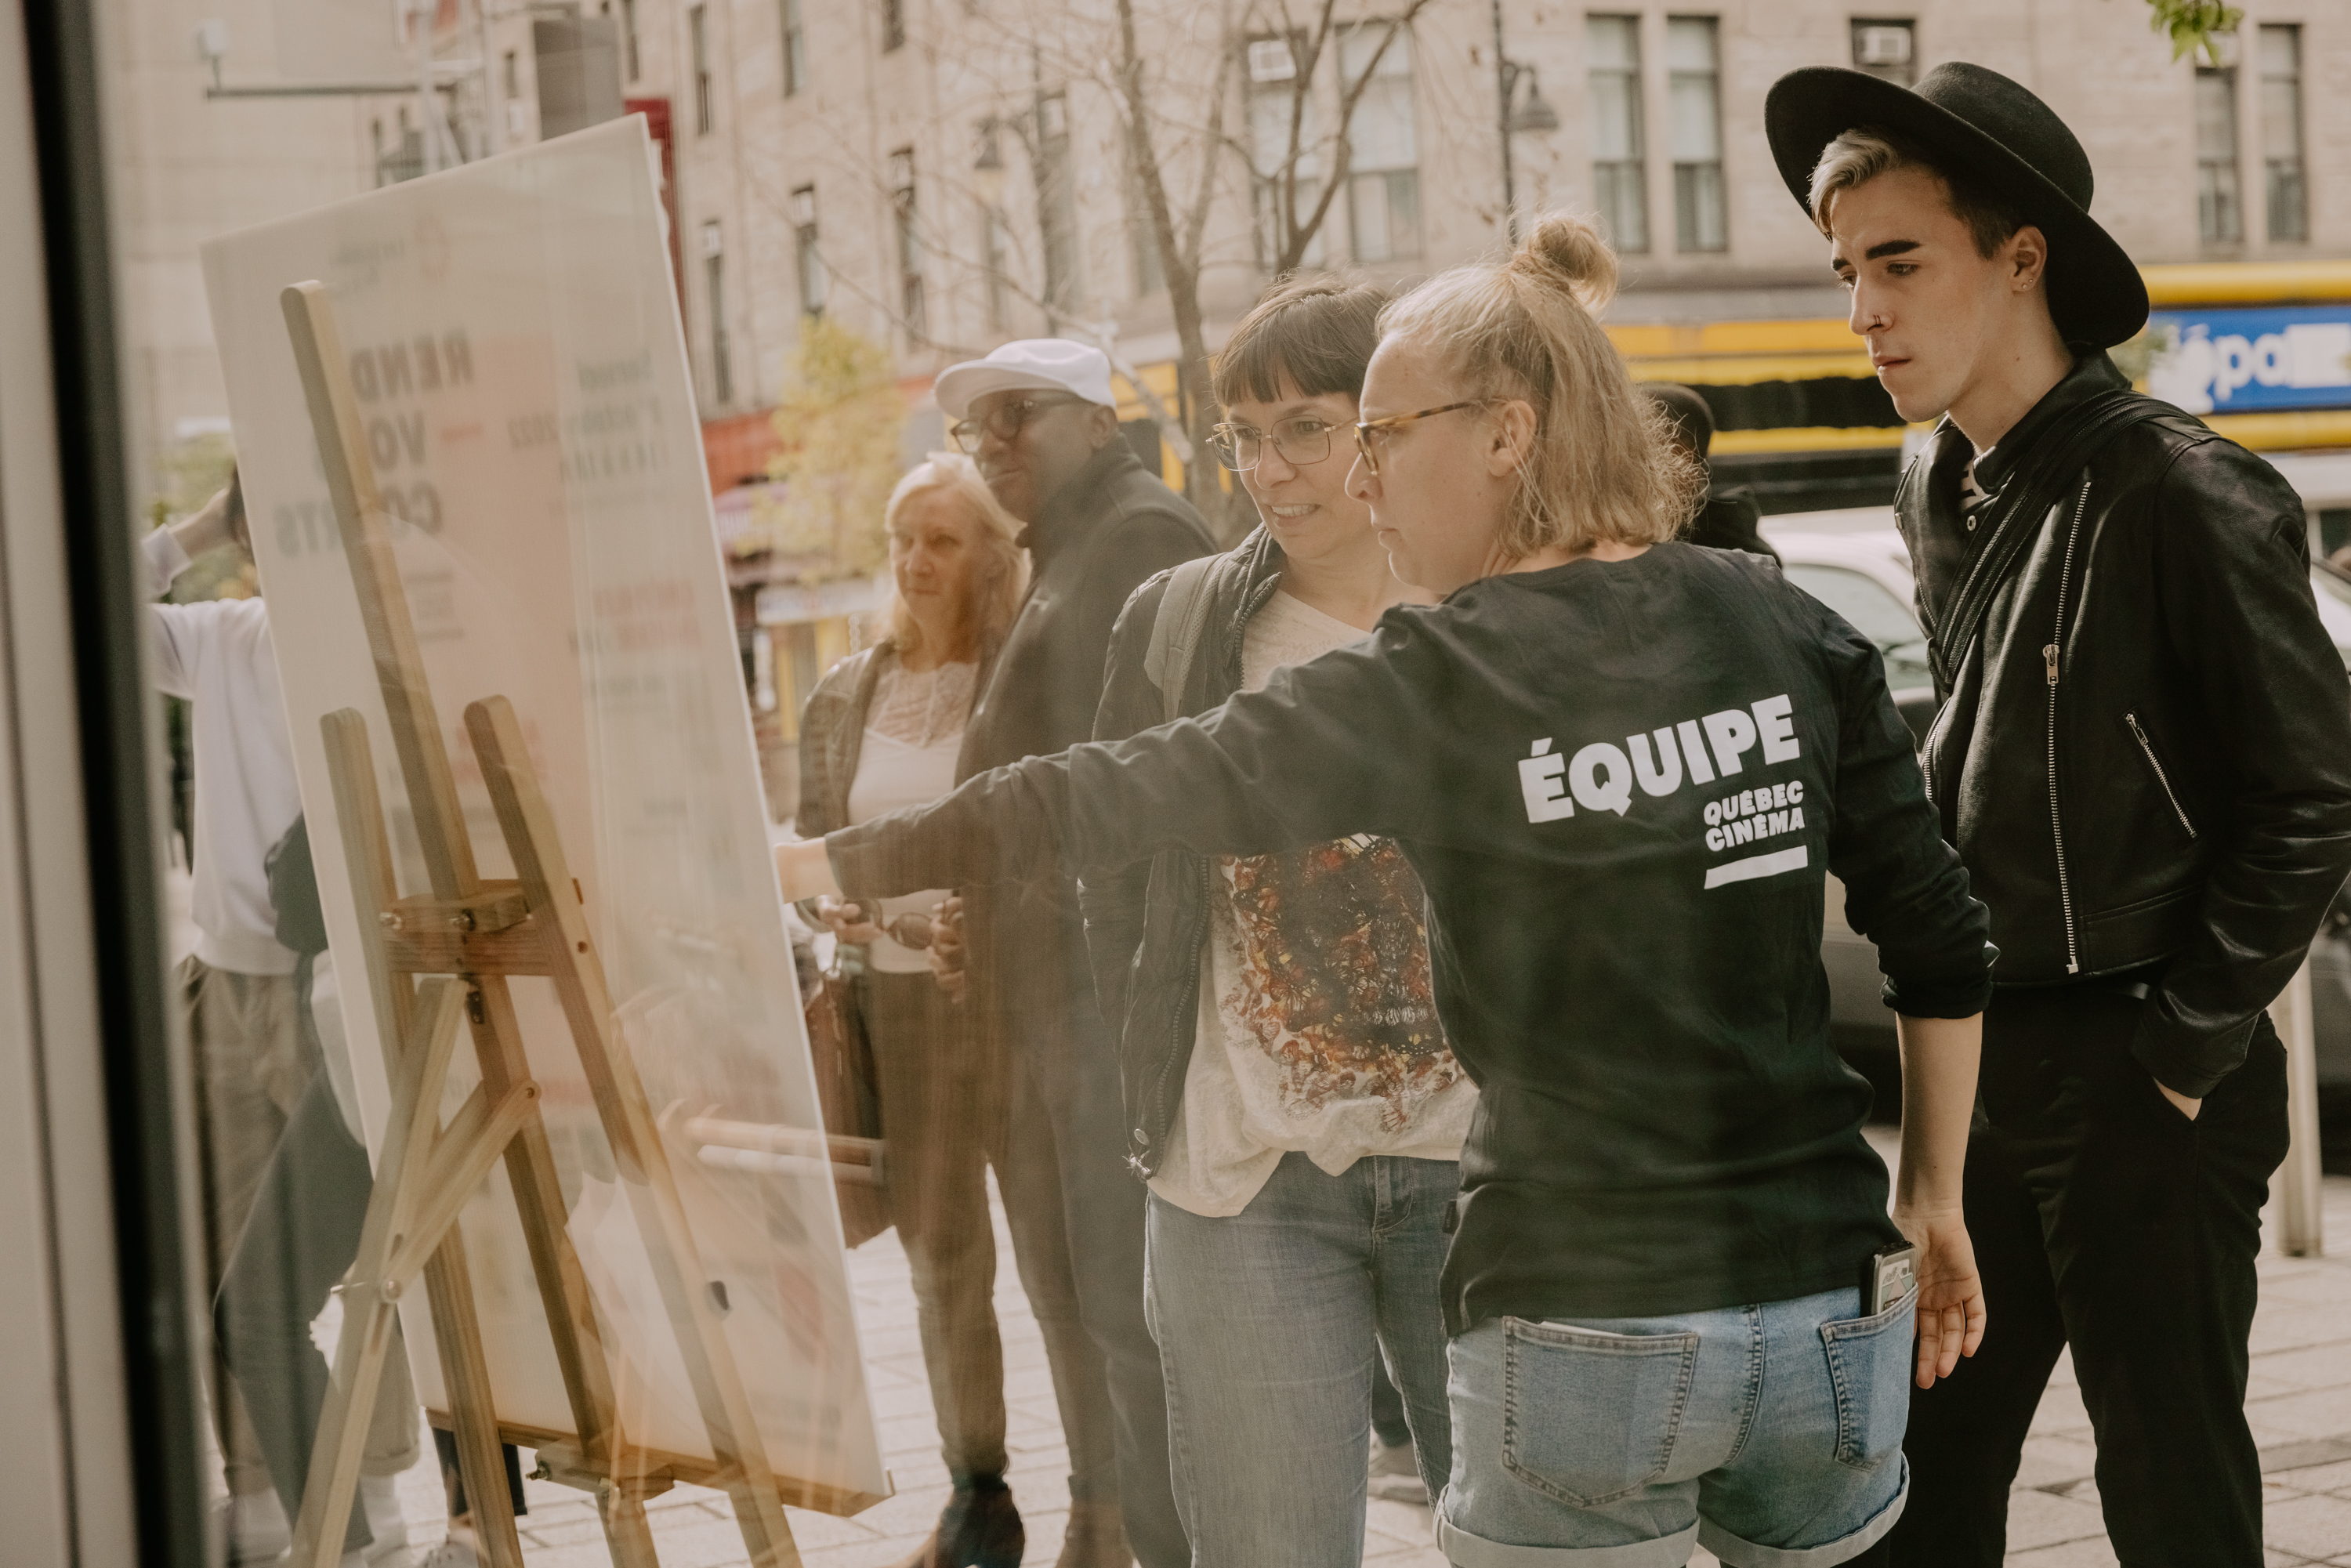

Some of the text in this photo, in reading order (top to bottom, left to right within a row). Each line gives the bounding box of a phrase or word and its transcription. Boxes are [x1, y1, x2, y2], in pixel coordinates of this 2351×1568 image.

[1518, 693, 1800, 824] ÉQUIPE
[1704, 780, 1803, 827] QUÉBEC
[1705, 807, 1805, 852] CINÉMA
